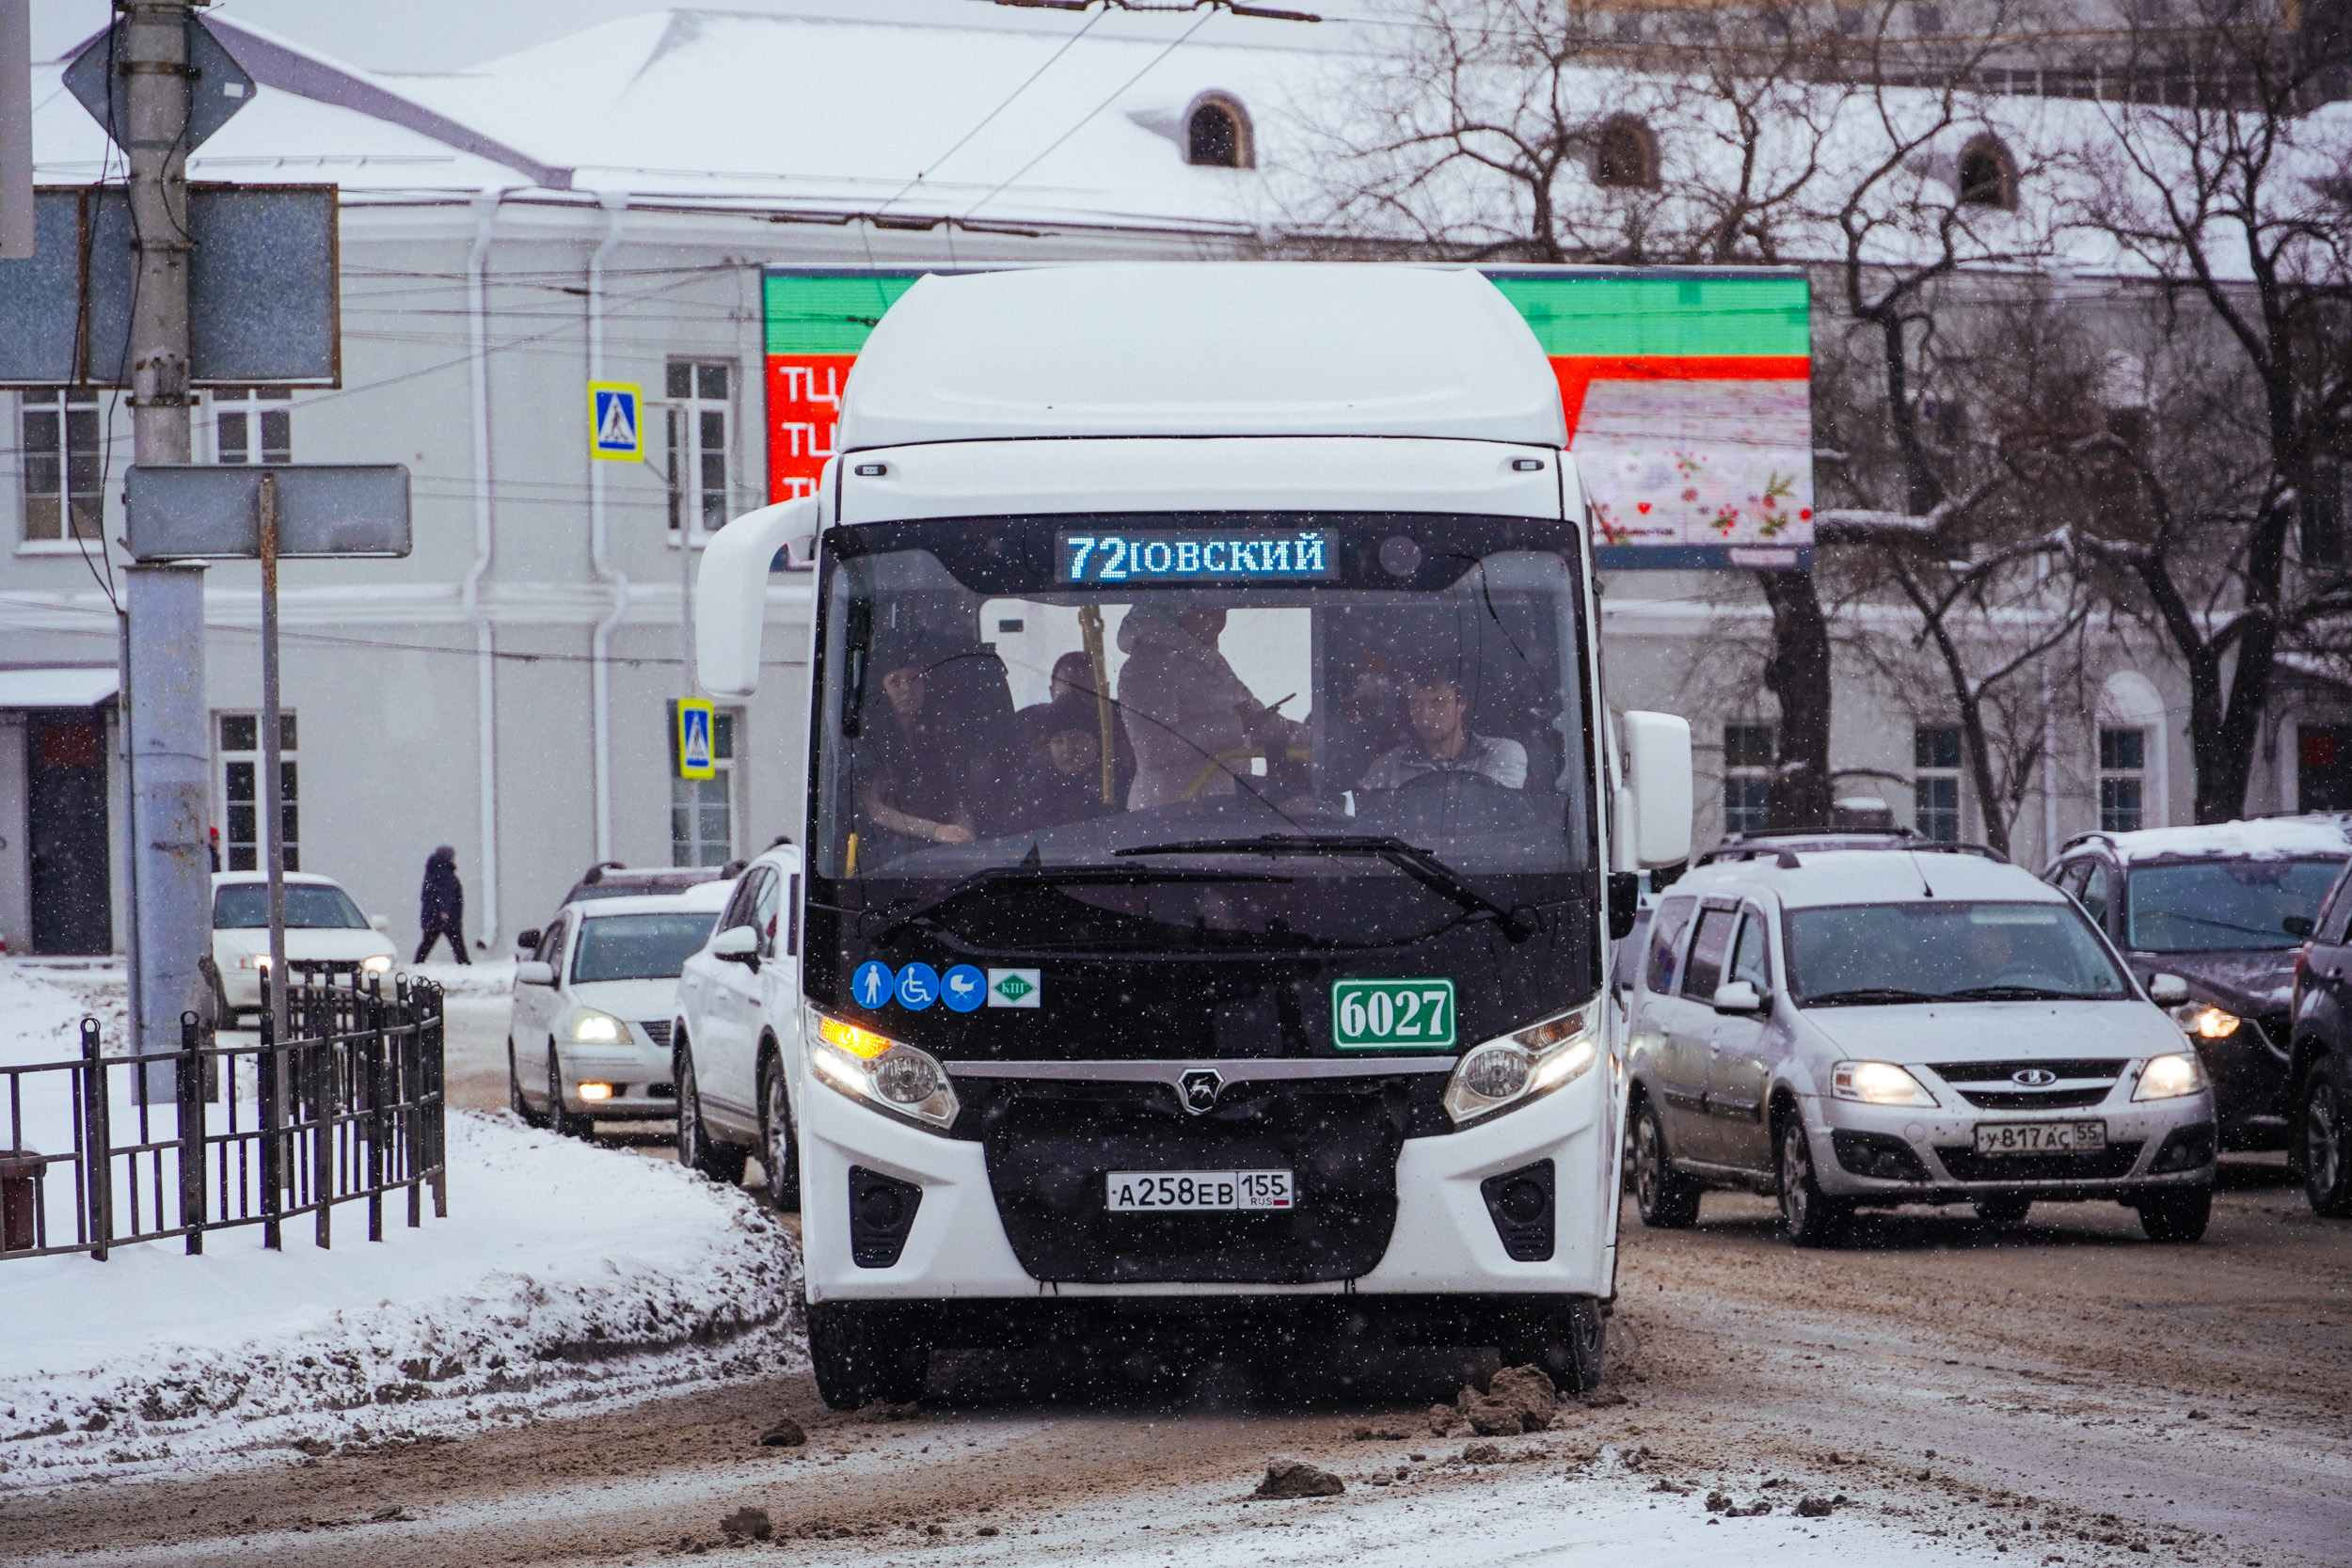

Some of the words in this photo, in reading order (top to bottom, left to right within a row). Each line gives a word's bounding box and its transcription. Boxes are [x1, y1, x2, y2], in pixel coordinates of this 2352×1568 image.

[779, 366, 840, 412] ТЦ
[1068, 537, 1126, 578] 72
[1002, 982, 1027, 993] КПГ
[1340, 990, 1447, 1037] 6027
[2077, 1124, 2097, 1140] 55
[1119, 1178, 1233, 1206] А258ЕВ
[1242, 1175, 1284, 1196] 155
[1250, 1197, 1273, 1206] RUS
